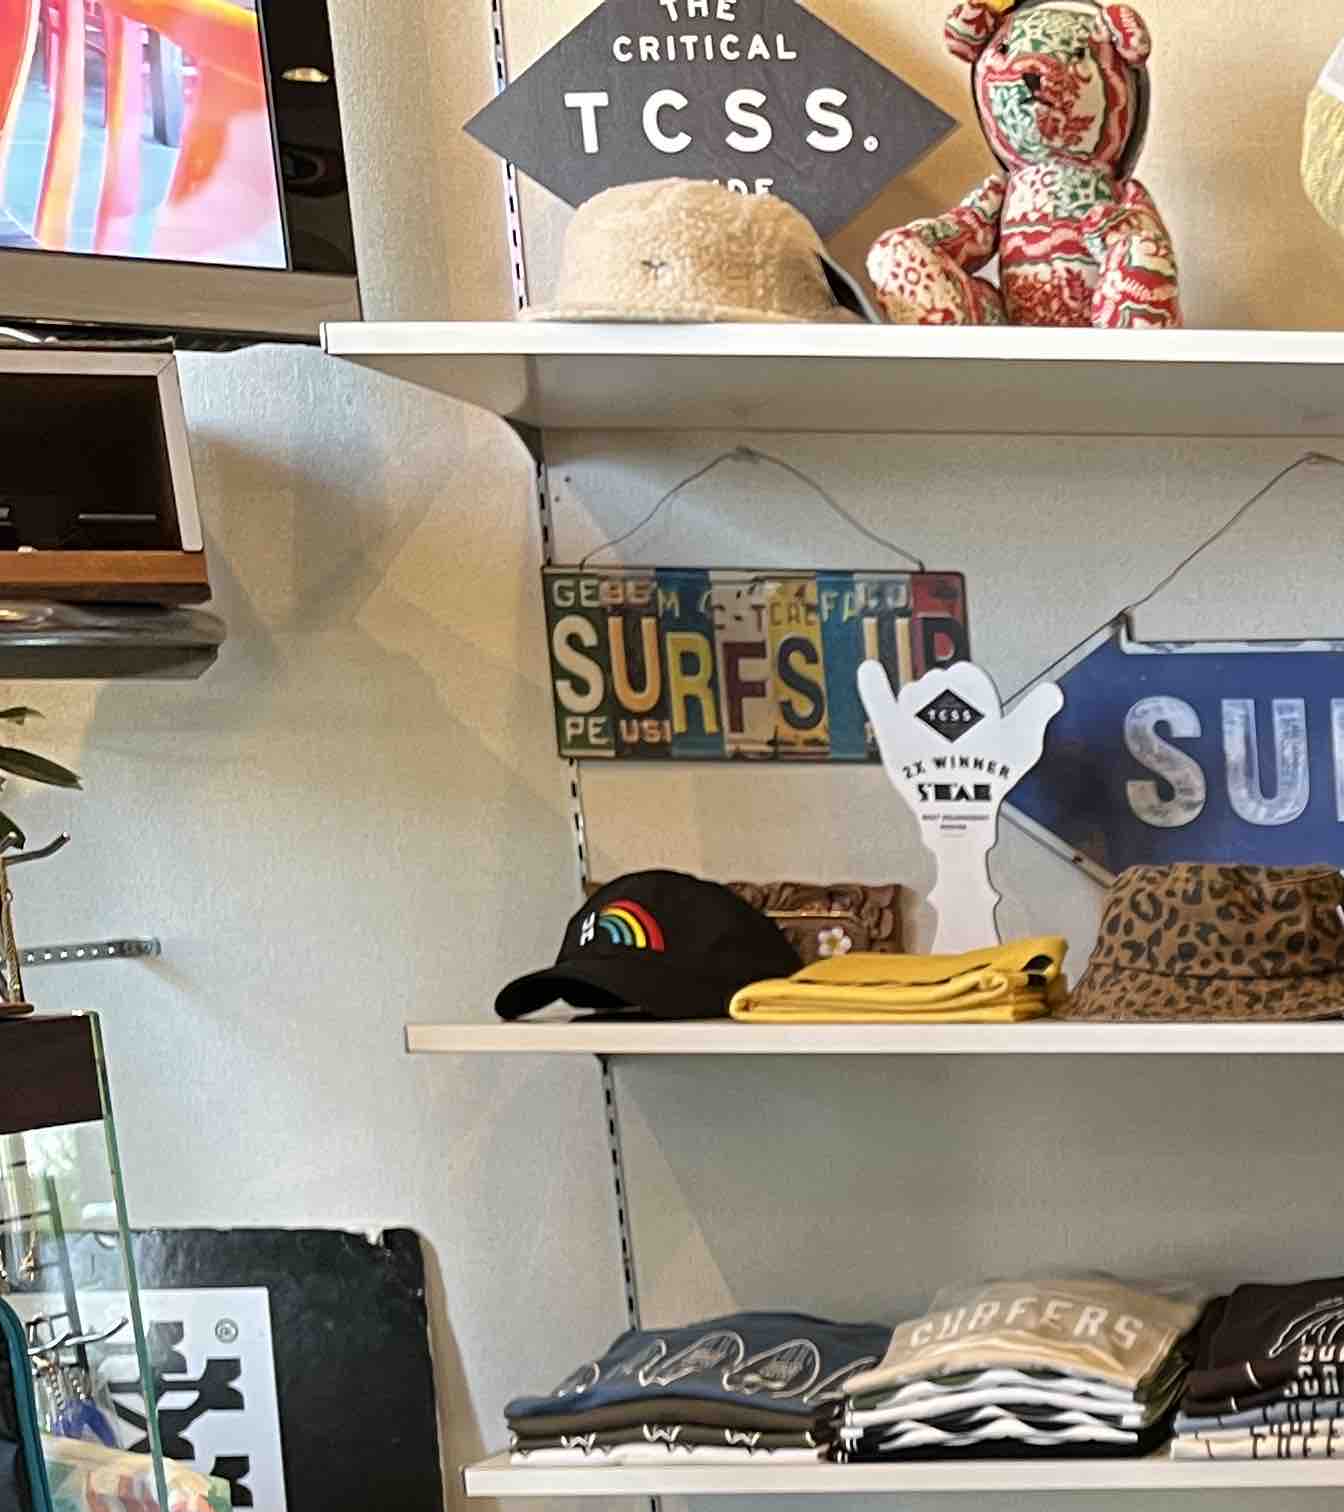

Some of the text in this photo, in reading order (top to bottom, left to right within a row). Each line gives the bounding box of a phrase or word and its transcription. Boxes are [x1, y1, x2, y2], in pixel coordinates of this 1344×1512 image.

[658, 0, 738, 22] THE
[612, 33, 798, 63] CRITICAL
[551, 614, 829, 734] SURFS
[932, 755, 1010, 780] WINNER
